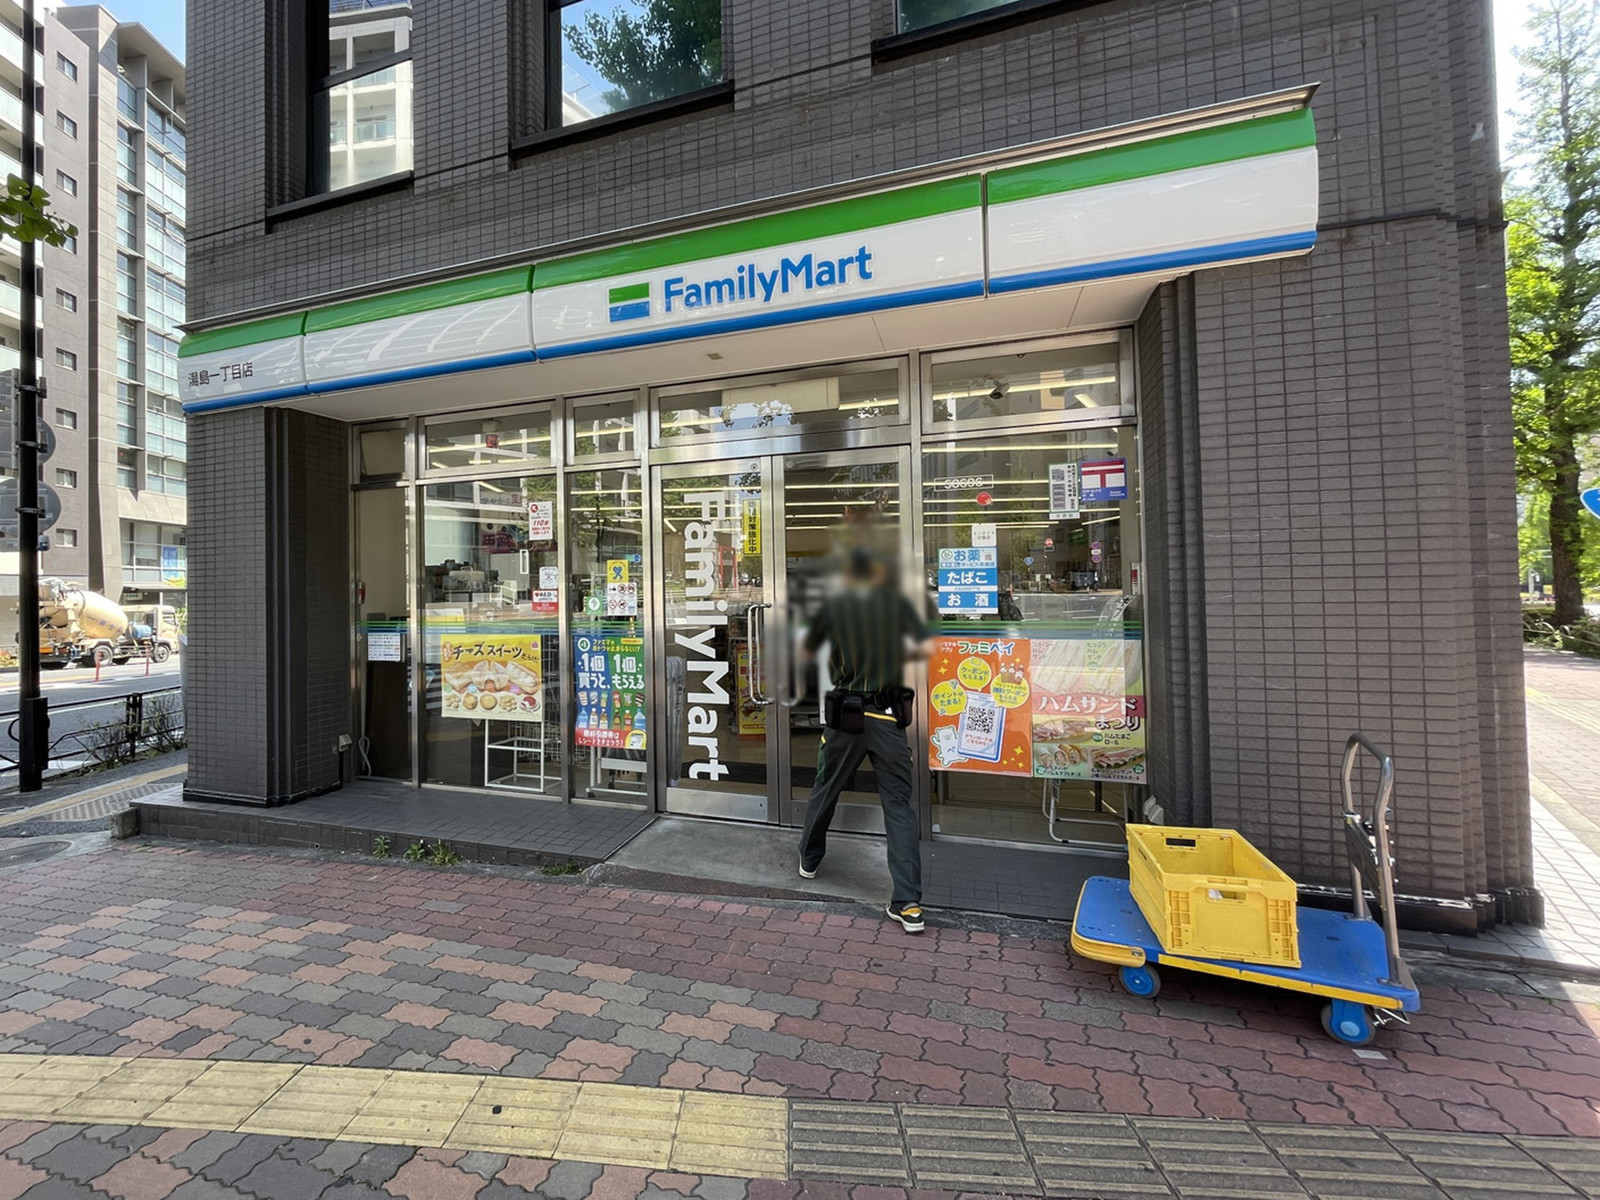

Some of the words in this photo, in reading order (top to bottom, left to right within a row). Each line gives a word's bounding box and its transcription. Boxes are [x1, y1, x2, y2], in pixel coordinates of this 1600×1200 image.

[664, 245, 872, 313] FamilyMart
[188, 362, 253, 387] 湯島一丁目店
[954, 549, 981, 561] お薬
[947, 571, 988, 584] たばこ
[947, 593, 989, 606] お酒
[674, 491, 729, 781] FamilyMart
[958, 641, 1015, 655] ファミペイ
[612, 674, 644, 689] もらえる
[1038, 695, 1136, 715] ハムサンド
[1095, 714, 1140, 731] まつり
